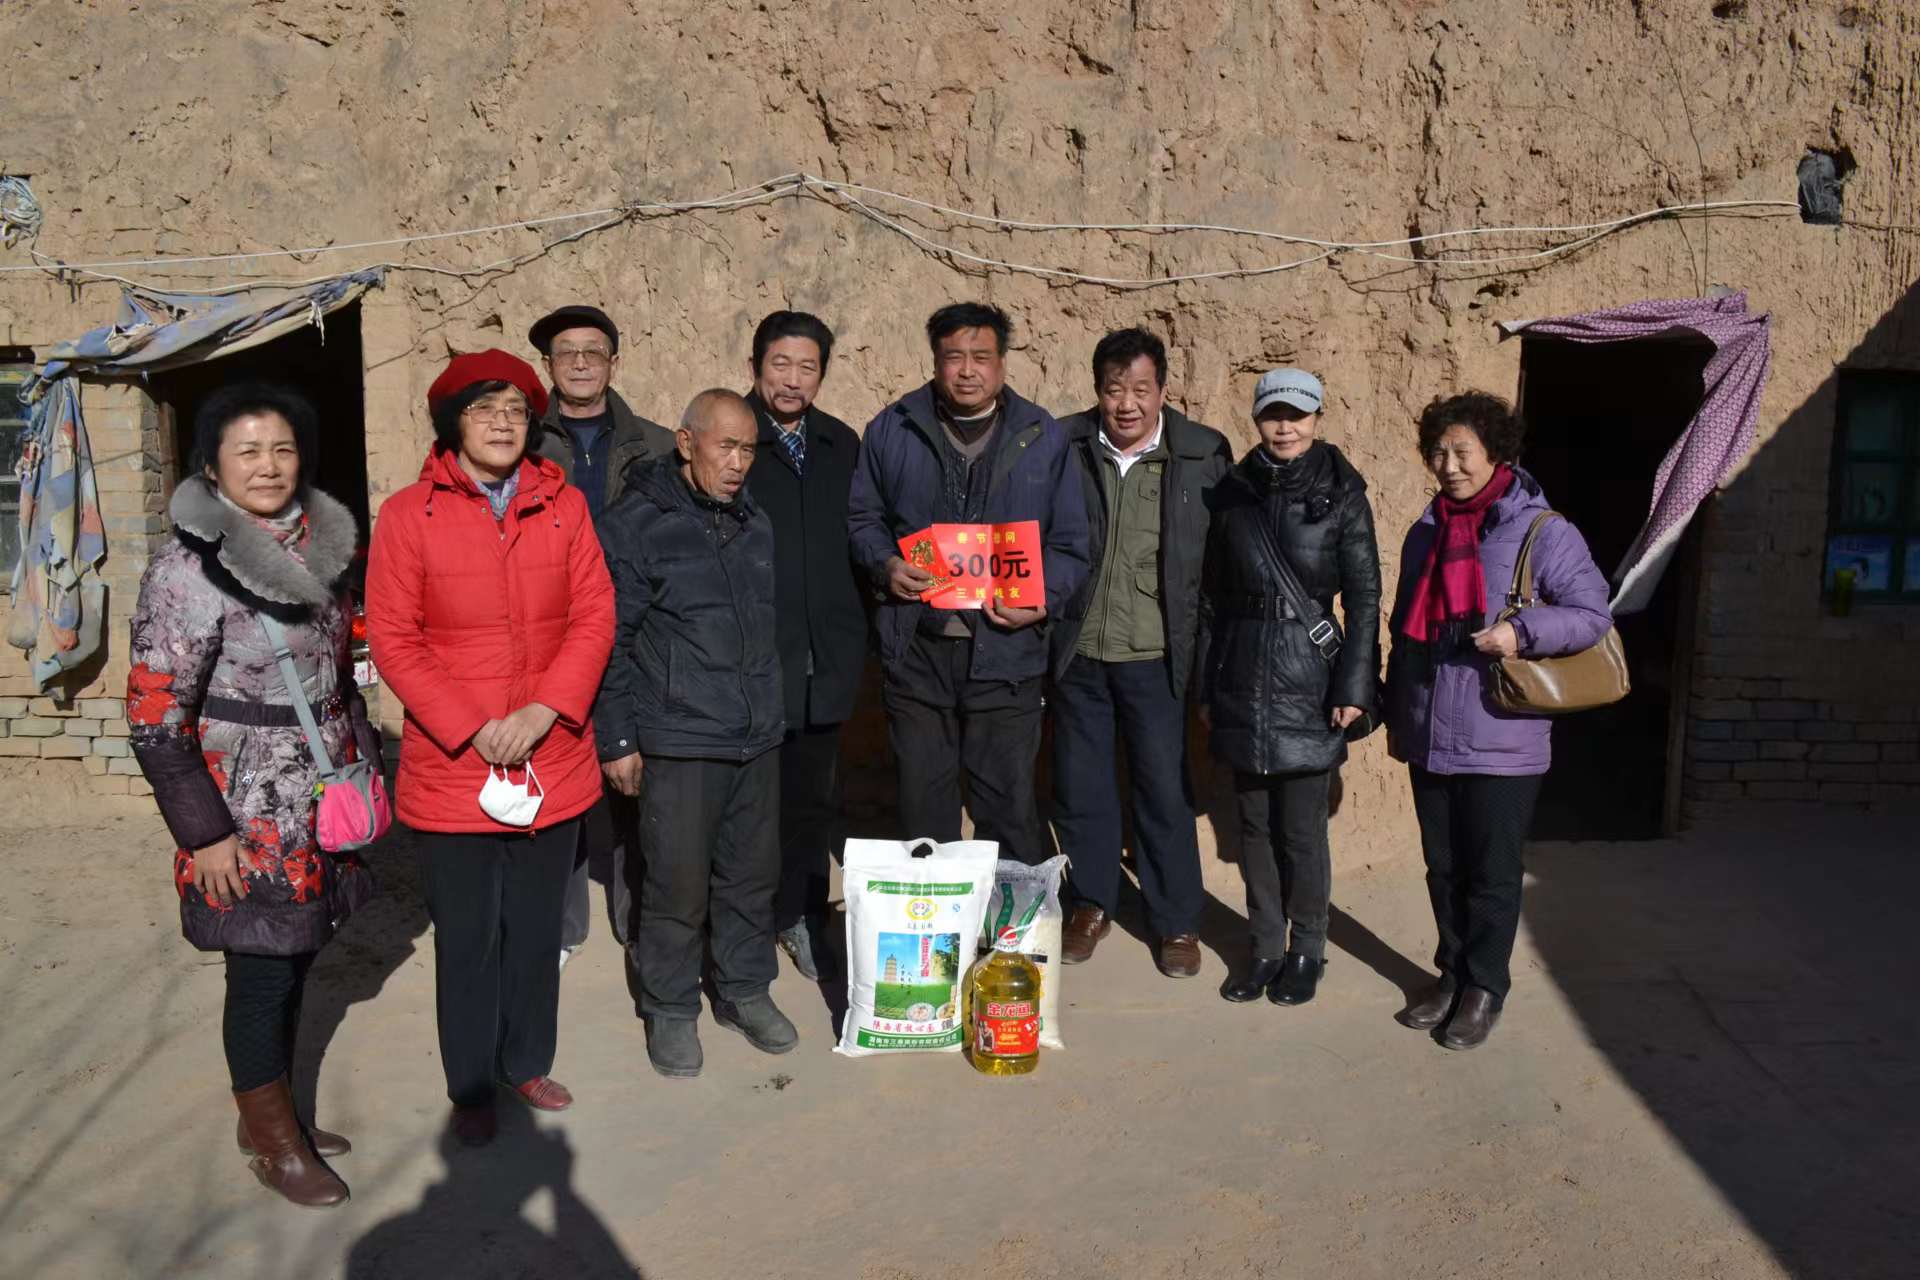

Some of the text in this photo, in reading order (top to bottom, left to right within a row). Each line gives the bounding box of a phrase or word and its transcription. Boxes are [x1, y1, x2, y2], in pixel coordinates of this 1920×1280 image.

[949, 551, 1031, 579] 300元
[987, 1003, 1031, 1017] 金龙鱼
